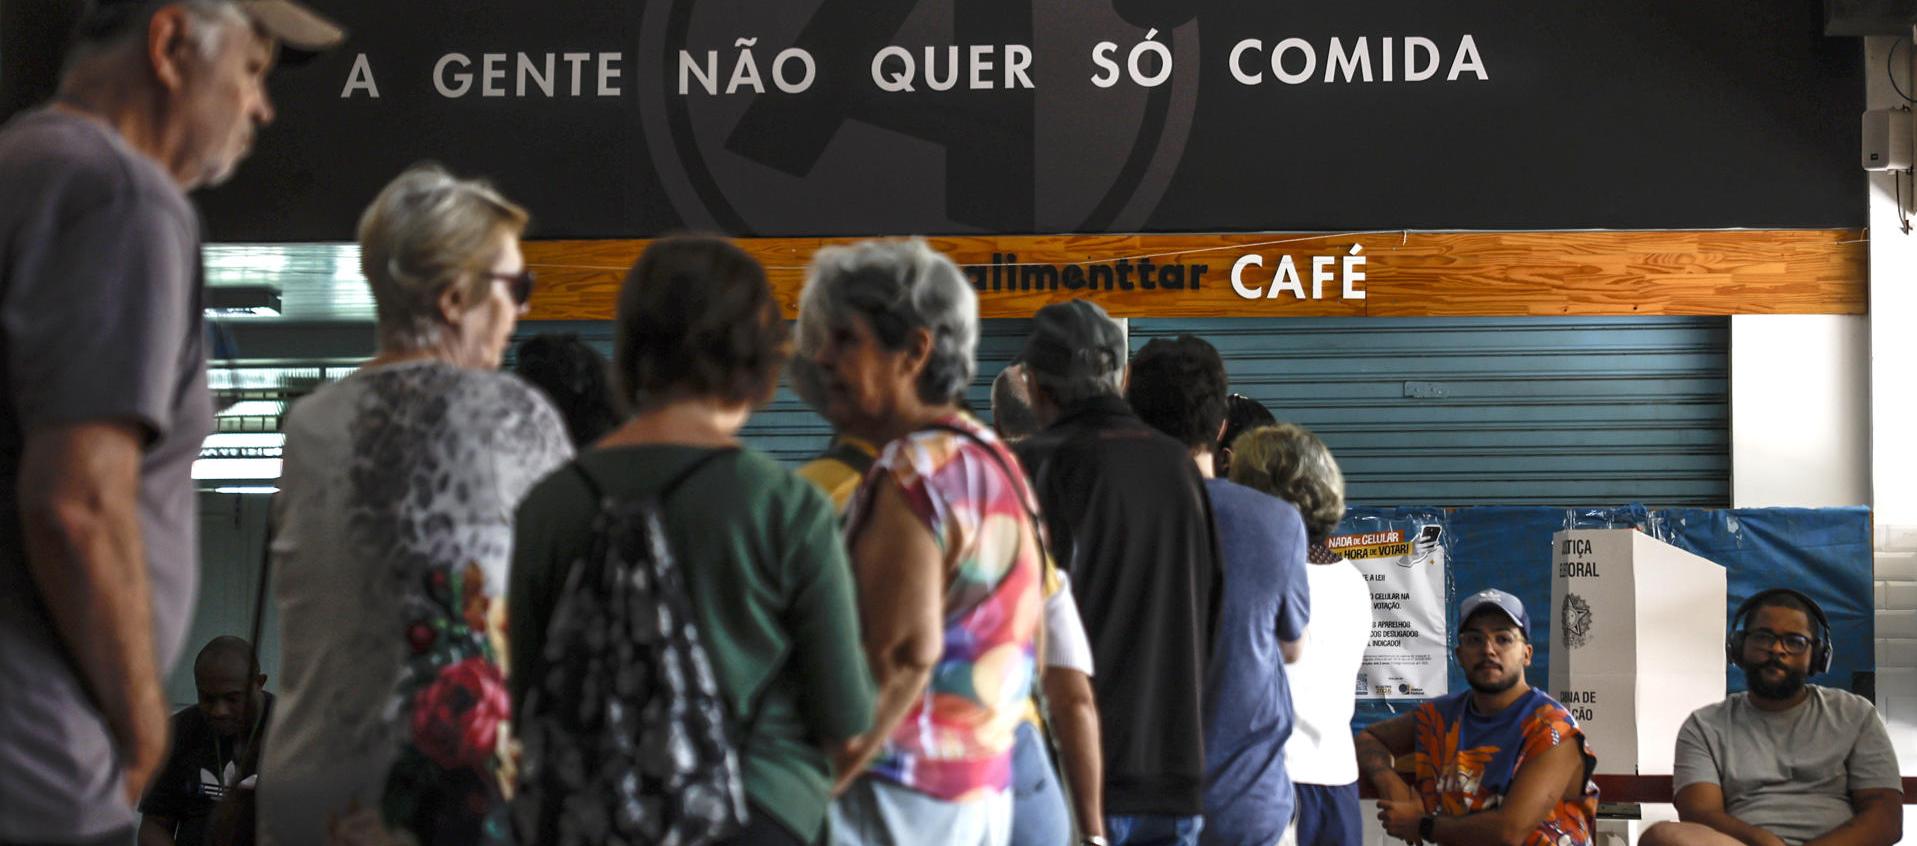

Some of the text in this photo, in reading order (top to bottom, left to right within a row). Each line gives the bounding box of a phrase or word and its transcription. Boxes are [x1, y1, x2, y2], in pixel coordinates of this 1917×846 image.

[340, 28, 1489, 98] A GENTE NÃO QUER SÓ COMIDA
[1230, 243, 1367, 300] CAFÉ
[1328, 536, 1352, 548] NADA
[1361, 531, 1399, 546] CELULAR
[1344, 548, 1368, 559] HORA
[1378, 543, 1409, 556] VOTAR!
[1375, 592, 1400, 600] CELULAR
[1401, 592, 1410, 600] NA
[1582, 691, 1597, 703] DE
[1571, 706, 1593, 721] ÇÃO
